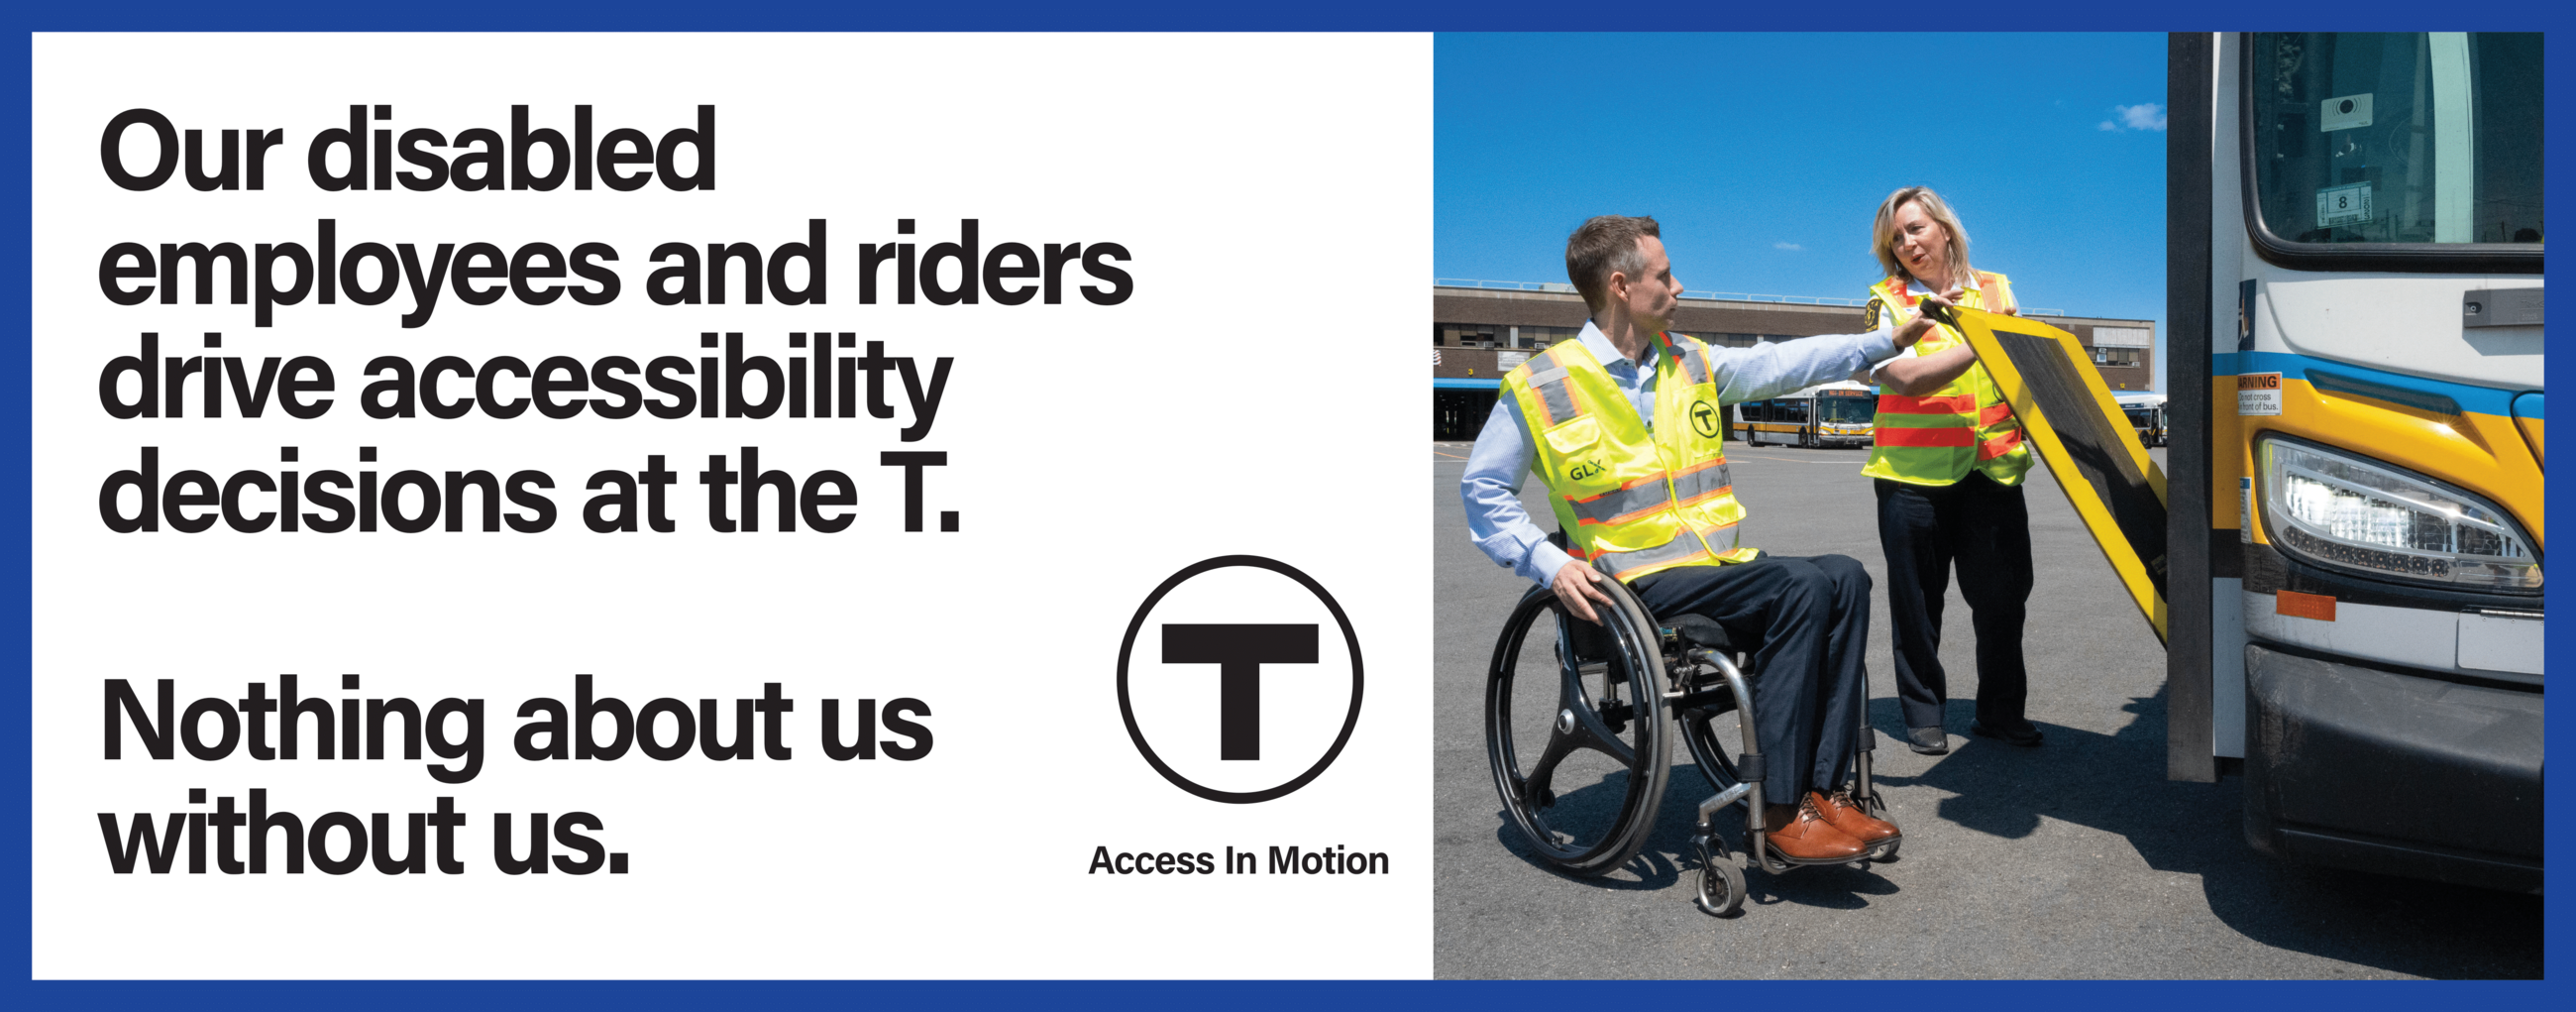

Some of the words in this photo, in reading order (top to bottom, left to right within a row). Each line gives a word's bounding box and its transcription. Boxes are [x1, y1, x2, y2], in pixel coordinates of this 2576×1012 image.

[101, 109, 282, 191] Our
[308, 105, 714, 191] disabled
[2338, 195, 2348, 209] 8
[99, 219, 620, 328] employees
[647, 219, 826, 305] and
[859, 219, 1133, 305] riders
[99, 333, 335, 419] drive
[361, 333, 954, 442] accessibility
[1694, 408, 1712, 431] T
[2238, 376, 2277, 389] ARNING
[2254, 401, 2262, 410] of
[2263, 401, 2279, 410] bus.
[99, 447, 557, 533] decisions
[584, 455, 677, 533] at
[699, 447, 857, 533] the
[881, 451, 959, 531] T.
[1569, 458, 1607, 481] GLX
[105, 674, 483, 784] Nothing
[514, 674, 793, 761] about
[822, 698, 933, 761] us
[1162, 624, 1319, 760] T
[97, 788, 466, 875] without
[494, 812, 628, 875] us.
[1089, 846, 1215, 874] Access
[1227, 846, 1255, 874] In
[1269, 844, 1388, 874] Motion
